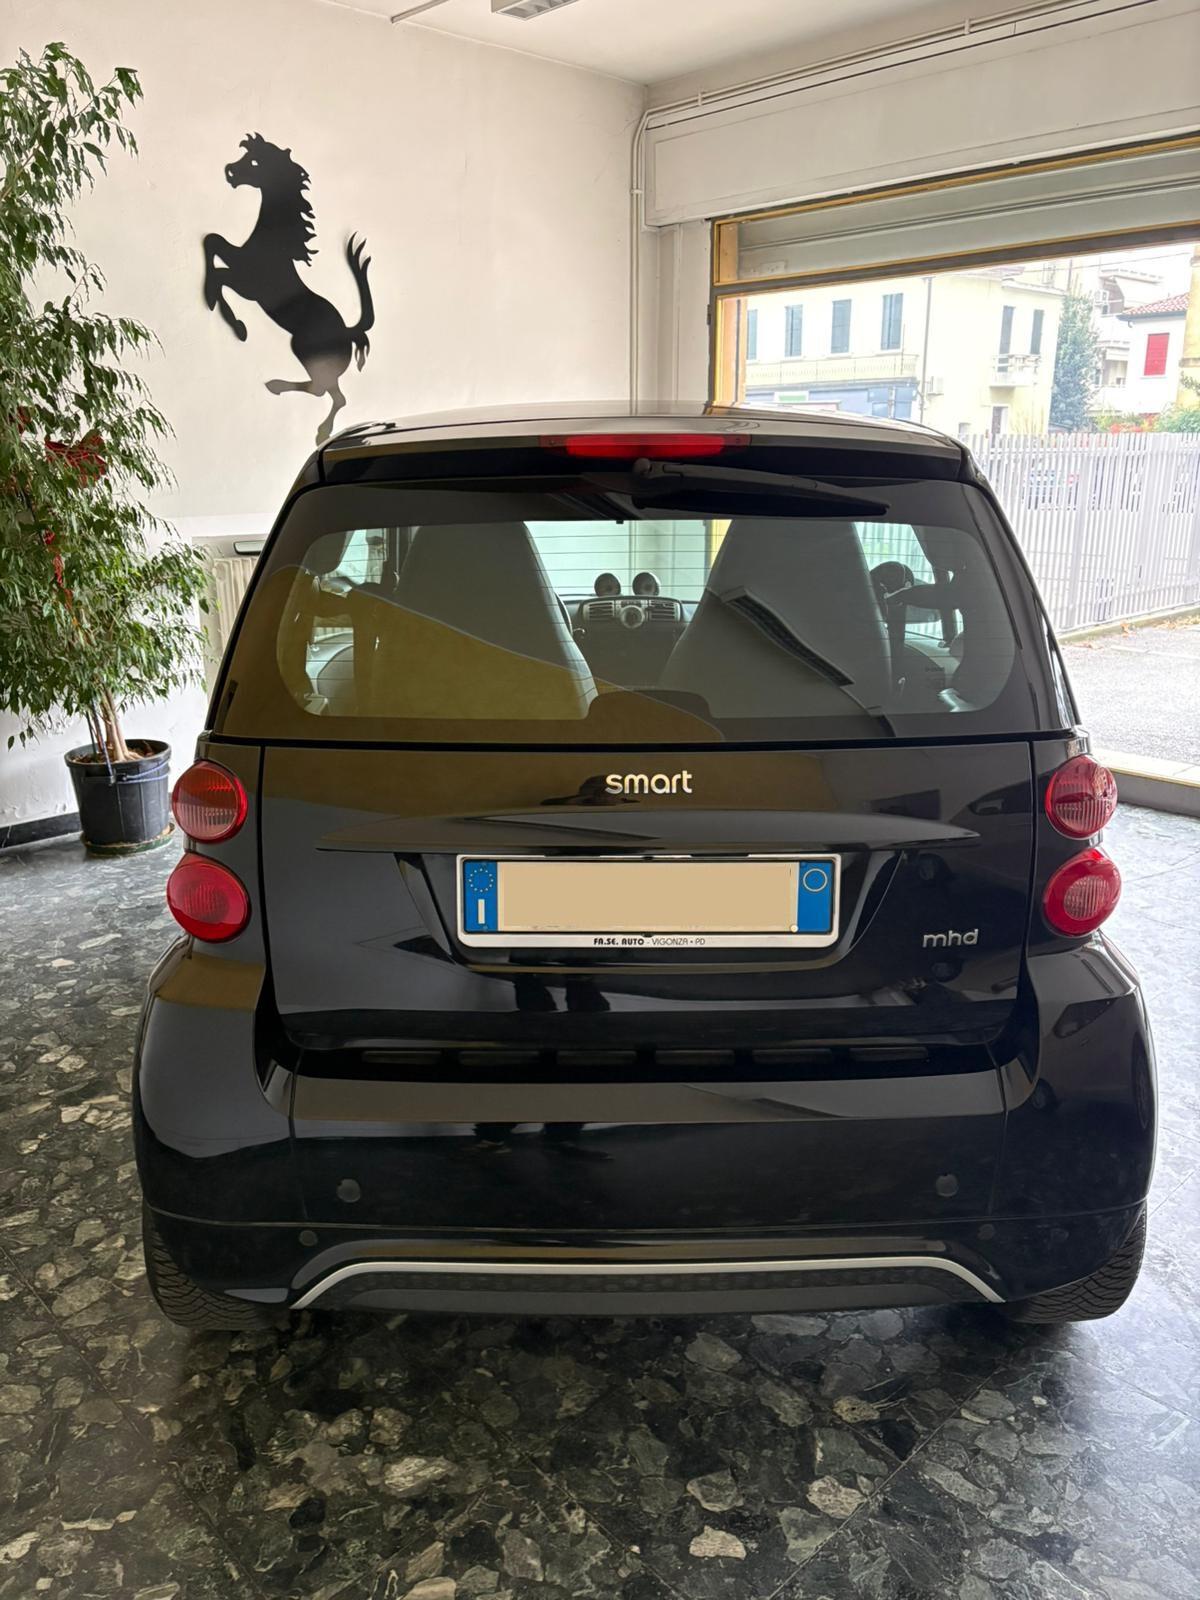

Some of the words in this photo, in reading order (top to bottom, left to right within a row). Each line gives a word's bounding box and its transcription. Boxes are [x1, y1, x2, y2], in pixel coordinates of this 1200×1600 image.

[605, 770, 693, 794] smart
[593, 937, 619, 946] FA.SE.
[621, 937, 645, 946] AUTO
[651, 937, 689, 946] VIGONZA
[695, 937, 706, 946] PD
[922, 928, 979, 948] mhd
